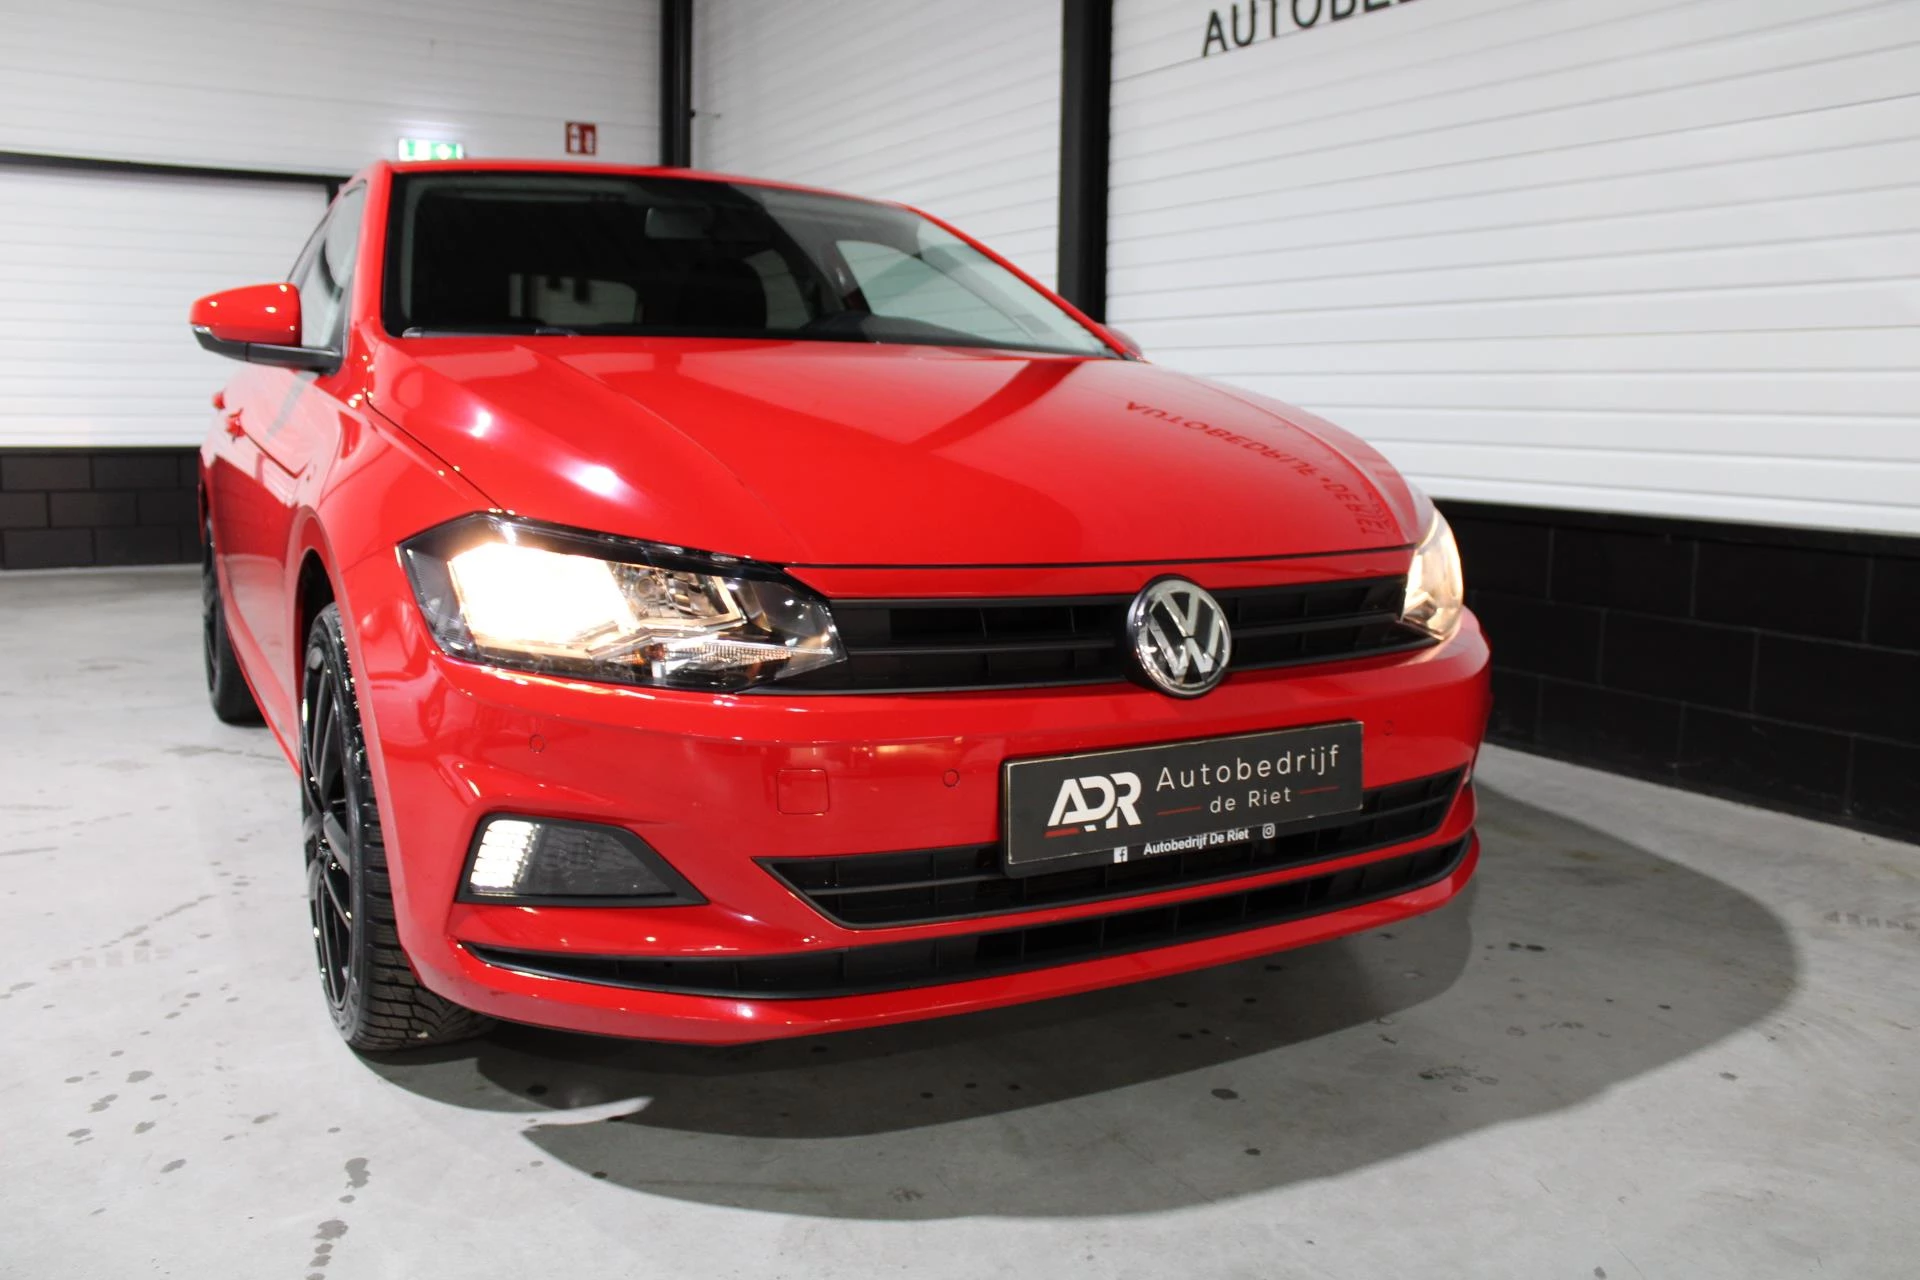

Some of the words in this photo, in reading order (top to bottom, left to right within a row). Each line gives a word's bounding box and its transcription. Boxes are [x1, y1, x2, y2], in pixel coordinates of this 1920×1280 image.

[1156, 744, 1339, 792] Autobedrijf
[1047, 771, 1142, 830] ADR
[1209, 795, 1236, 814] de
[1248, 786, 1292, 808] Riet
[1143, 833, 1208, 855] Autobedrijf
[1209, 832, 1225, 845] De
[1227, 828, 1250, 842] Riet
